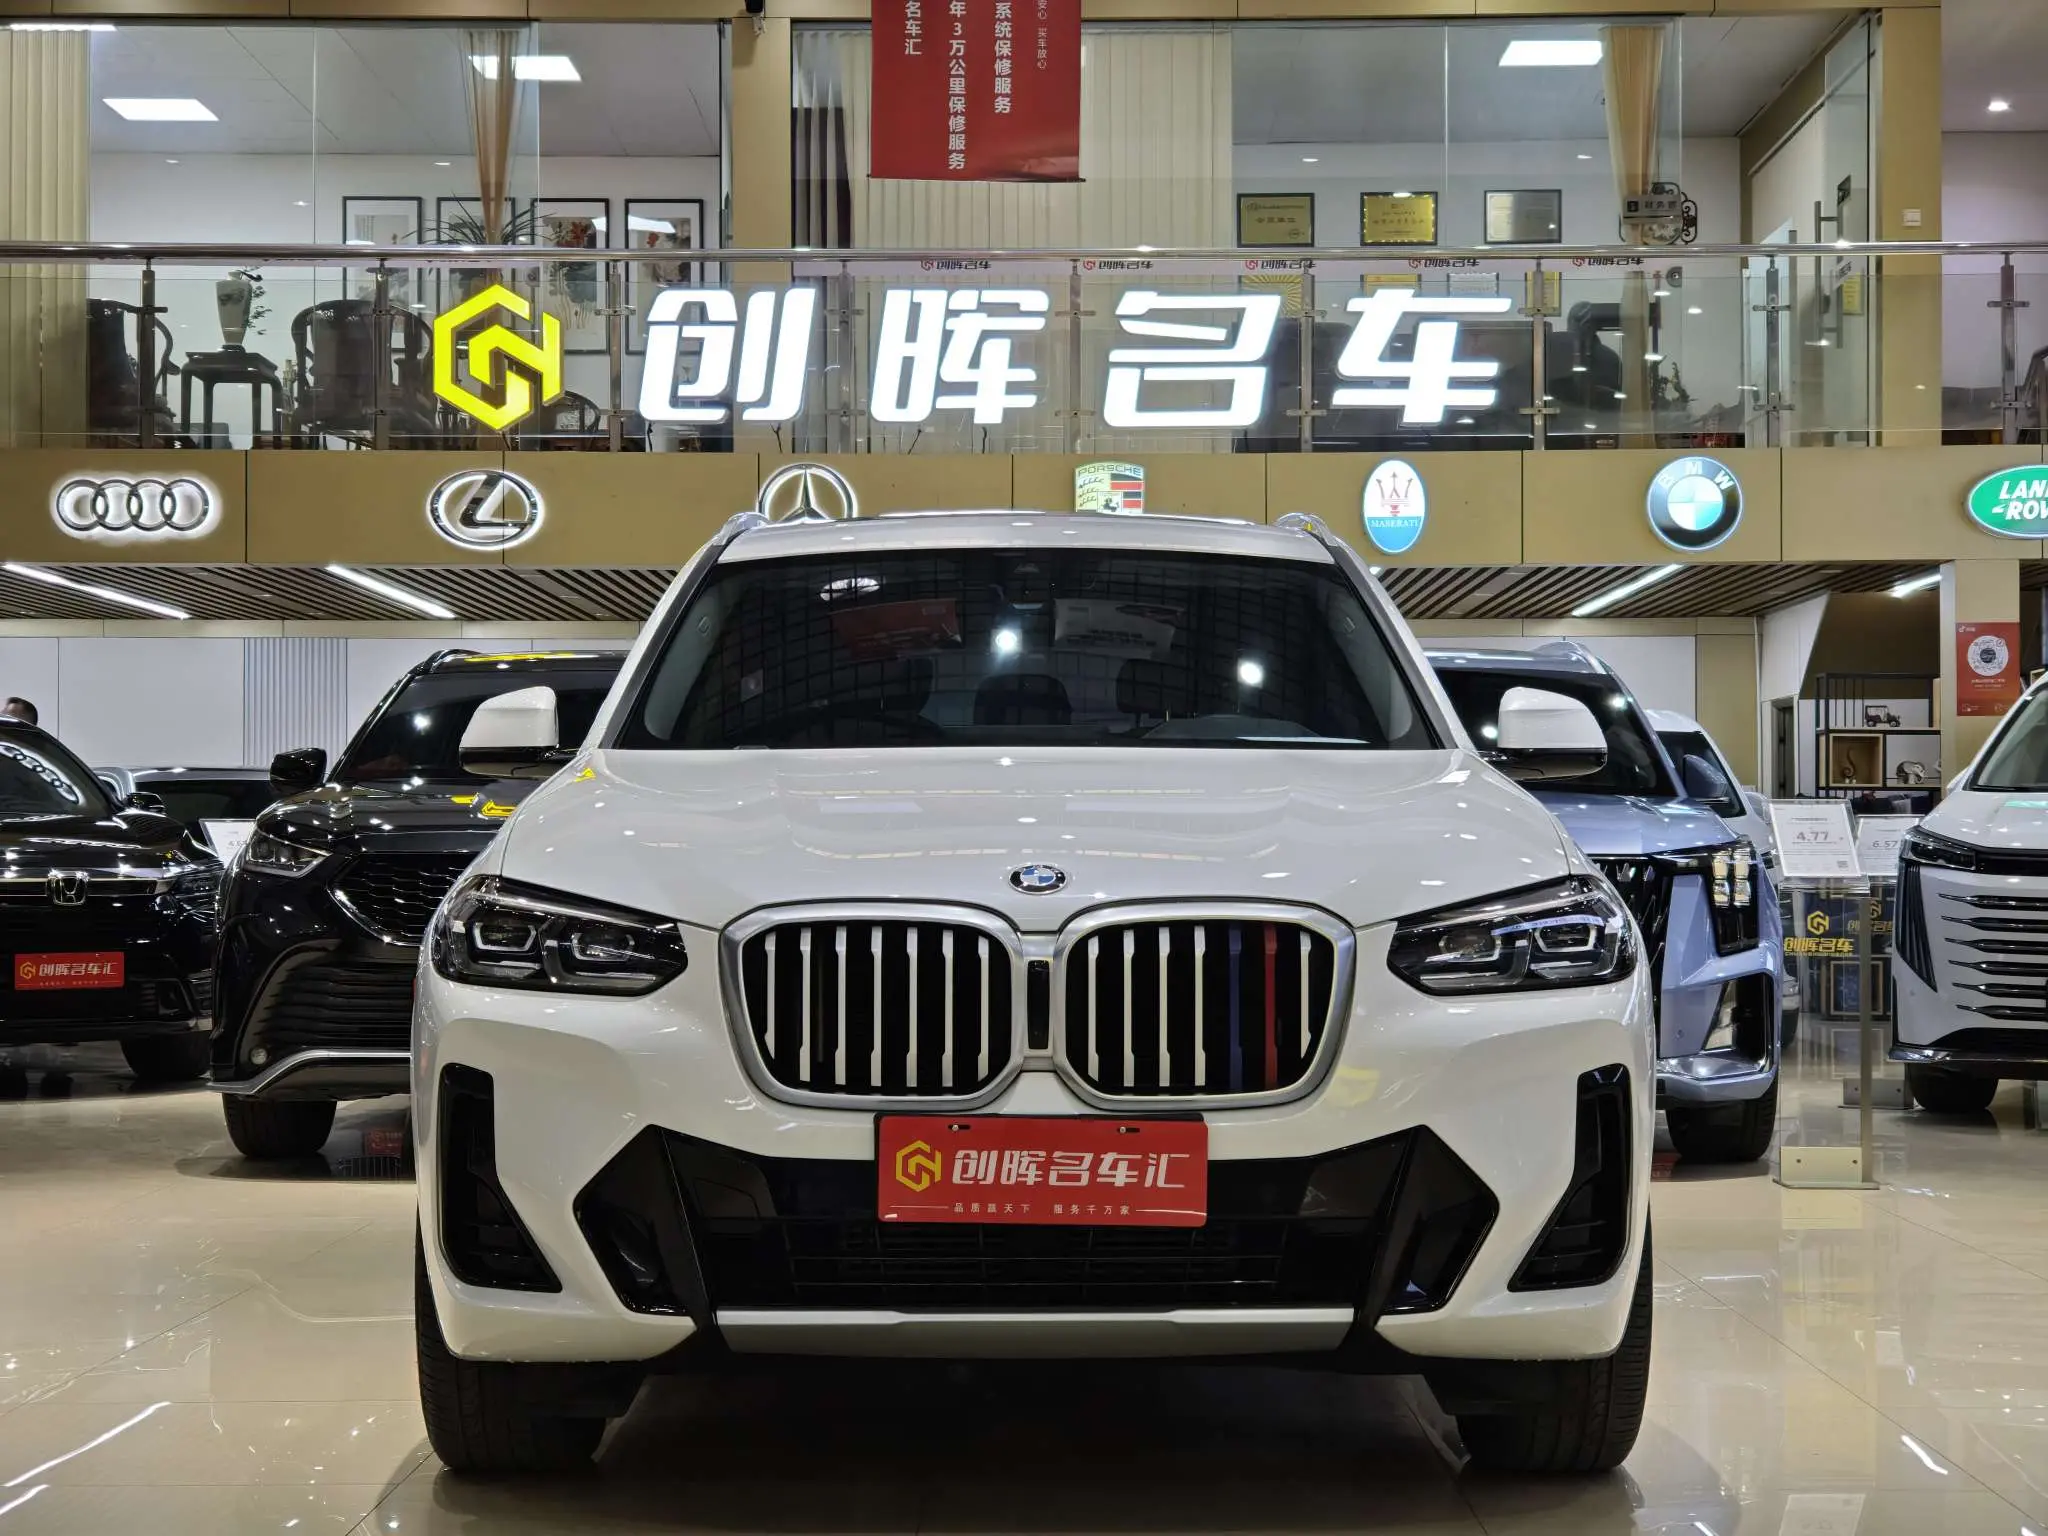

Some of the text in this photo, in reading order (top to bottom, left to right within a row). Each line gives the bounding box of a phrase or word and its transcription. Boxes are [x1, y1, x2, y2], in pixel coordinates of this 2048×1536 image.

[904, 0, 922, 55] 名车汇
[994, 1, 1012, 113] 系统保修服务
[948, 1, 966, 169] 年3万公里保修服务
[638, 286, 1513, 427] 创晖名车
[1078, 464, 1143, 477] PORSCHE
[1658, 460, 1736, 491] BMW
[1998, 479, 2048, 500] LAN
[1796, 831, 1829, 841] 4.77
[1872, 840, 1898, 848] 6.57
[39, 962, 118, 977] 创晖名车汇
[952, 1149, 1190, 1188] 创晖名车汇
[1053, 1203, 1131, 1216] 服务千万家
